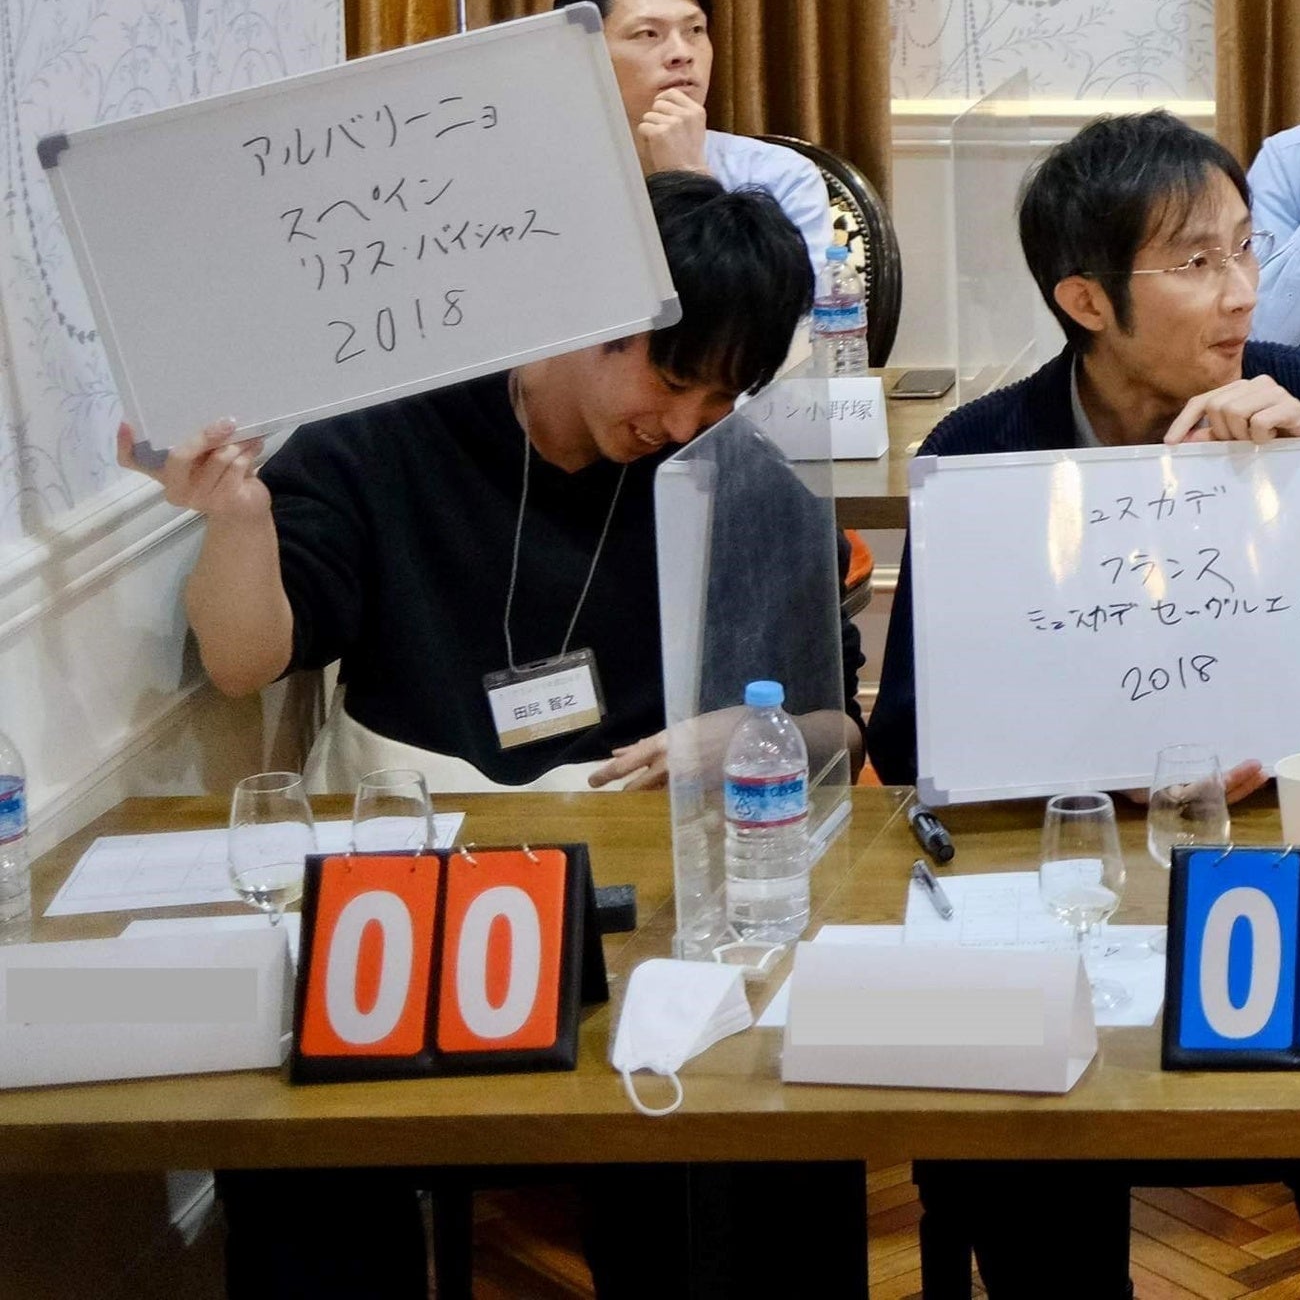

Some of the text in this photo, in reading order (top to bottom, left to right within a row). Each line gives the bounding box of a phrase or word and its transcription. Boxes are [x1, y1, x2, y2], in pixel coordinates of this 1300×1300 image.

[242, 96, 497, 176] アルバリーニョ
[280, 178, 455, 243] スペイン
[327, 289, 465, 364] 2018
[1090, 486, 1227, 524] ュスカデ
[1100, 548, 1235, 593] フランス
[1121, 655, 1218, 701] 2018
[326, 886, 542, 1045] 00
